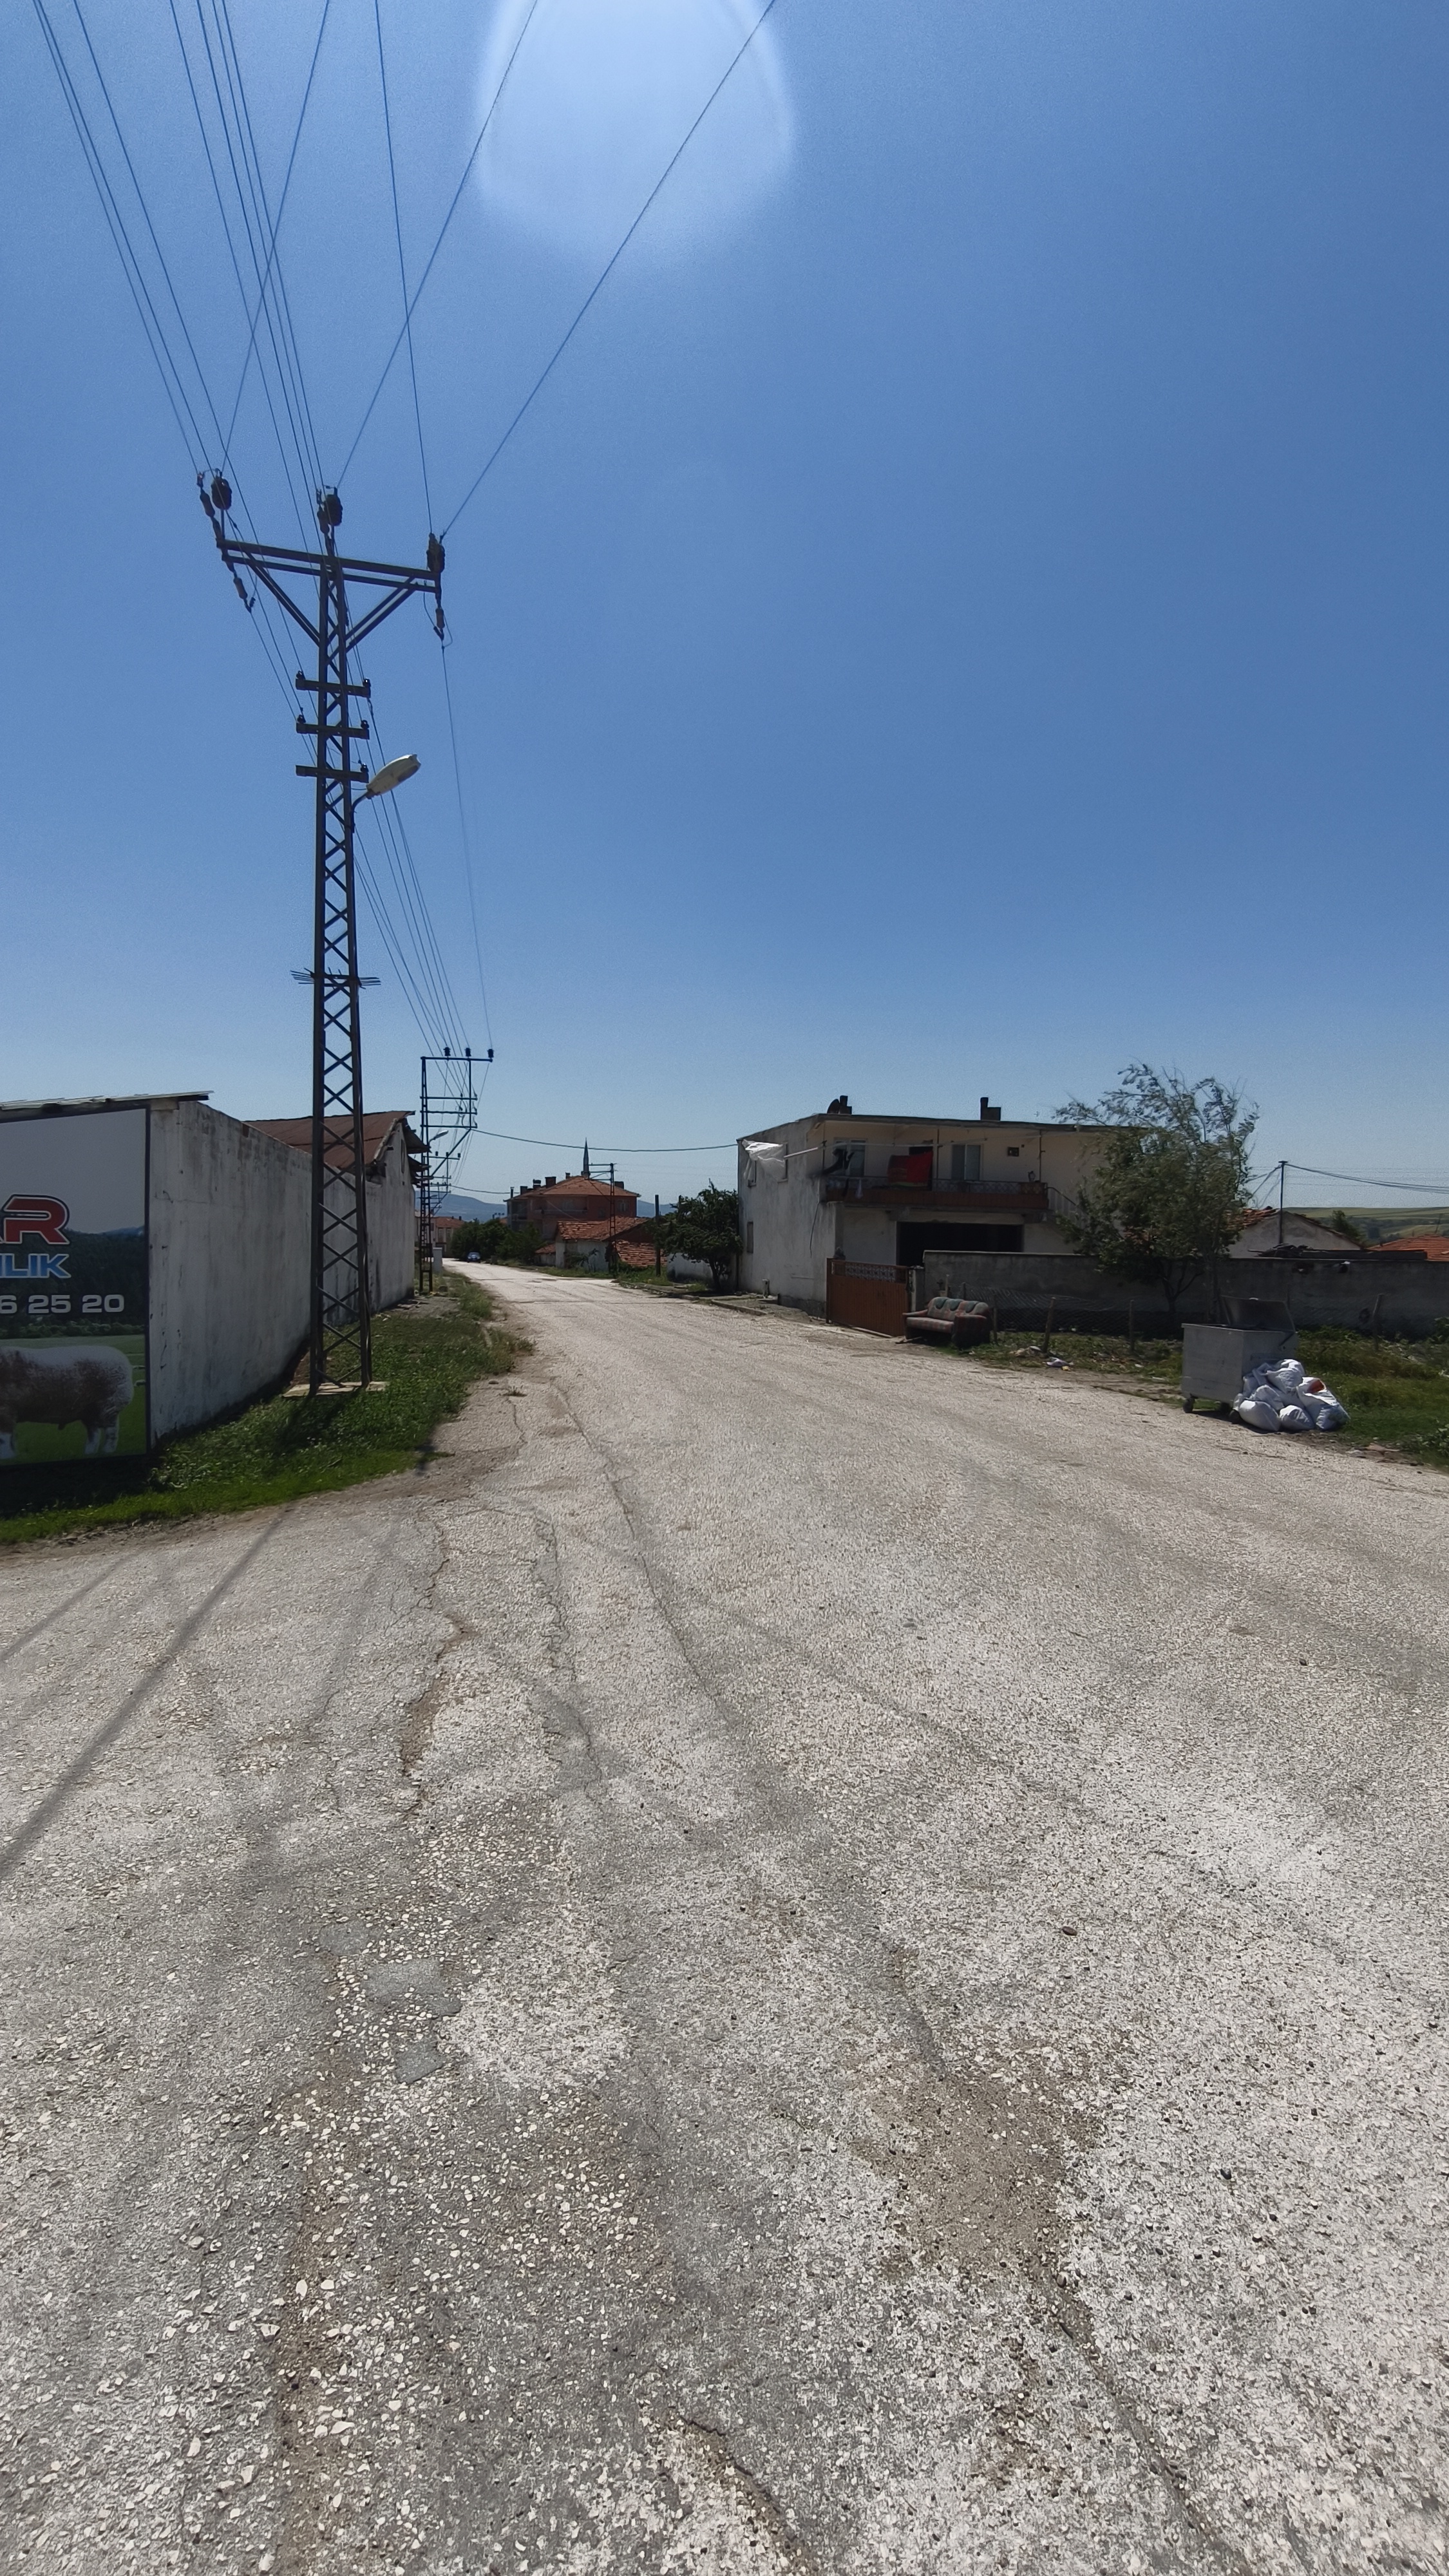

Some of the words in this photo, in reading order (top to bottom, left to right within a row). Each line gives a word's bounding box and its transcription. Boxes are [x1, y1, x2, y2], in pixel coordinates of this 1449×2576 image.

[0, 1194, 70, 1245] R
[0, 1295, 17, 1314] 6
[28, 1295, 71, 1314] 25
[82, 1294, 124, 1313] 20
